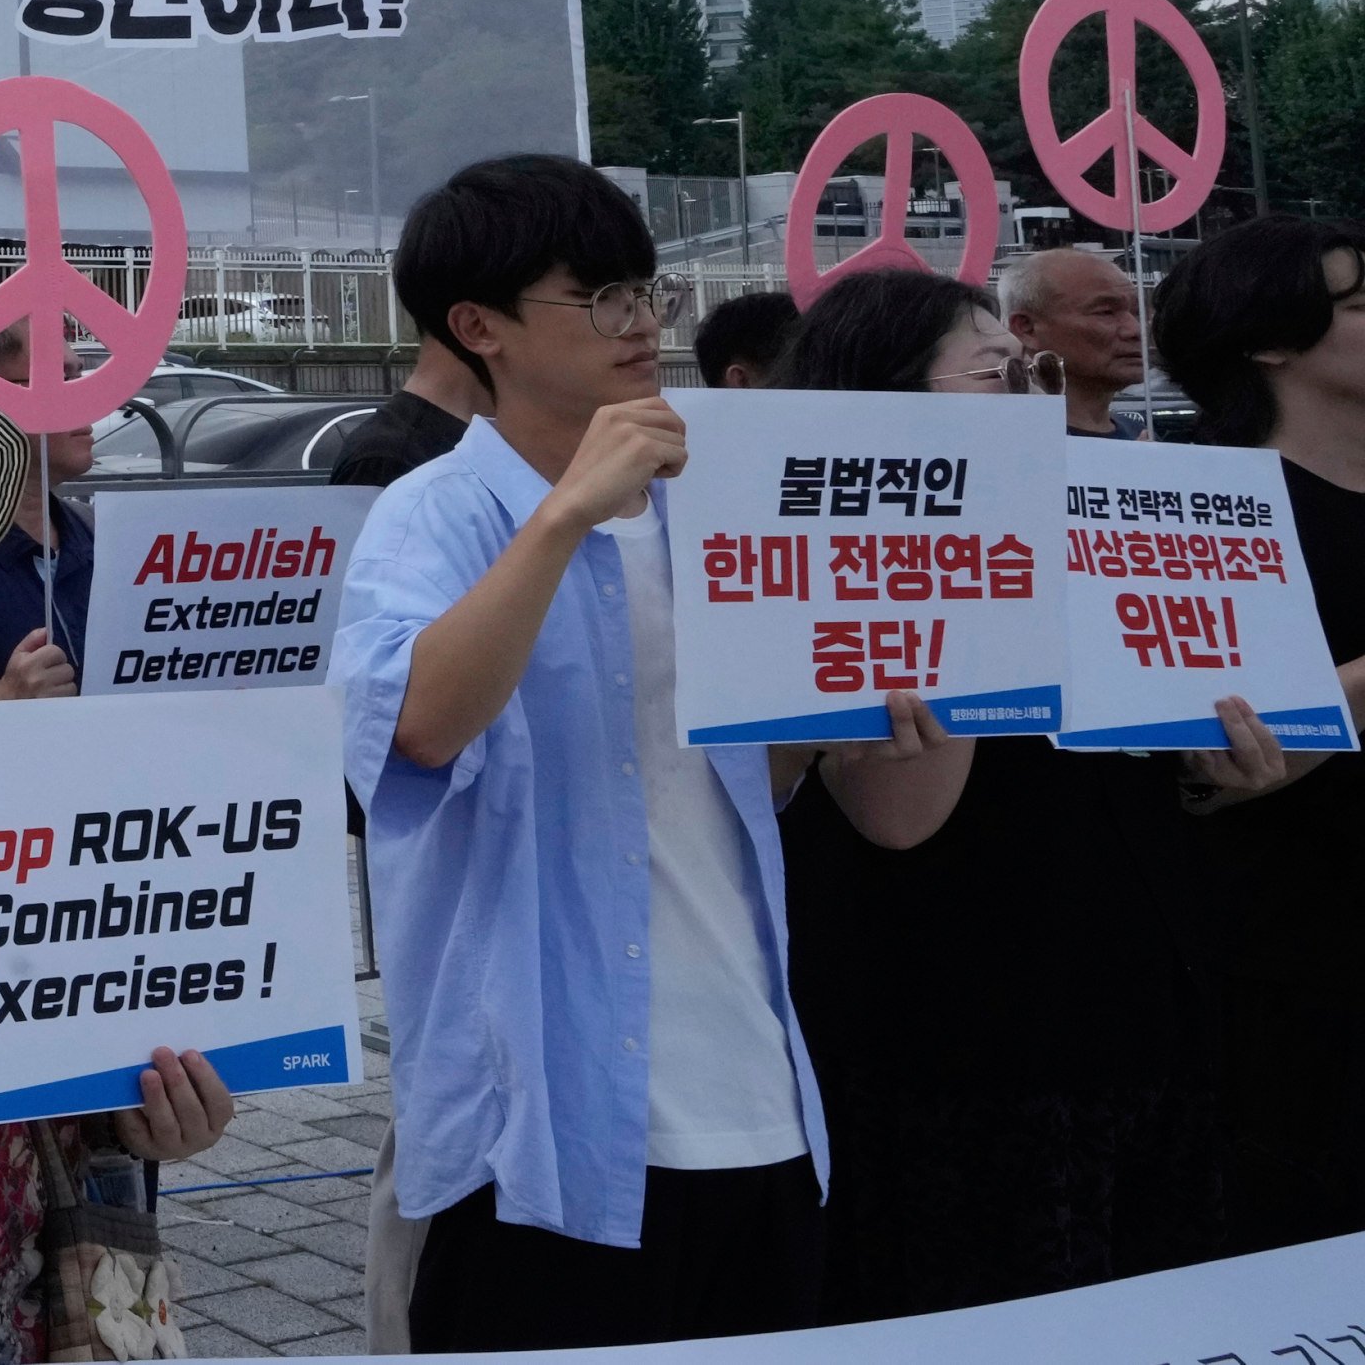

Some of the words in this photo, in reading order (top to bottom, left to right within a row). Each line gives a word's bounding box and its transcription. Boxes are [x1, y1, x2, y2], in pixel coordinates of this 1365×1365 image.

[778, 456, 968, 517] 불법적인
[1116, 488, 1185, 524] 전략적
[1190, 492, 1273, 528] 유연성은
[133, 526, 336, 585] Abolish
[703, 533, 809, 602] 한미
[830, 535, 1034, 601] 전쟁연습
[143, 588, 322, 632] Extended
[1115, 593, 1241, 668] 위반!
[112, 644, 321, 685] Deterrence
[812, 619, 946, 692] 중단!
[69, 798, 302, 867] ROK-US
[282, 1052, 331, 1071] SPARK
